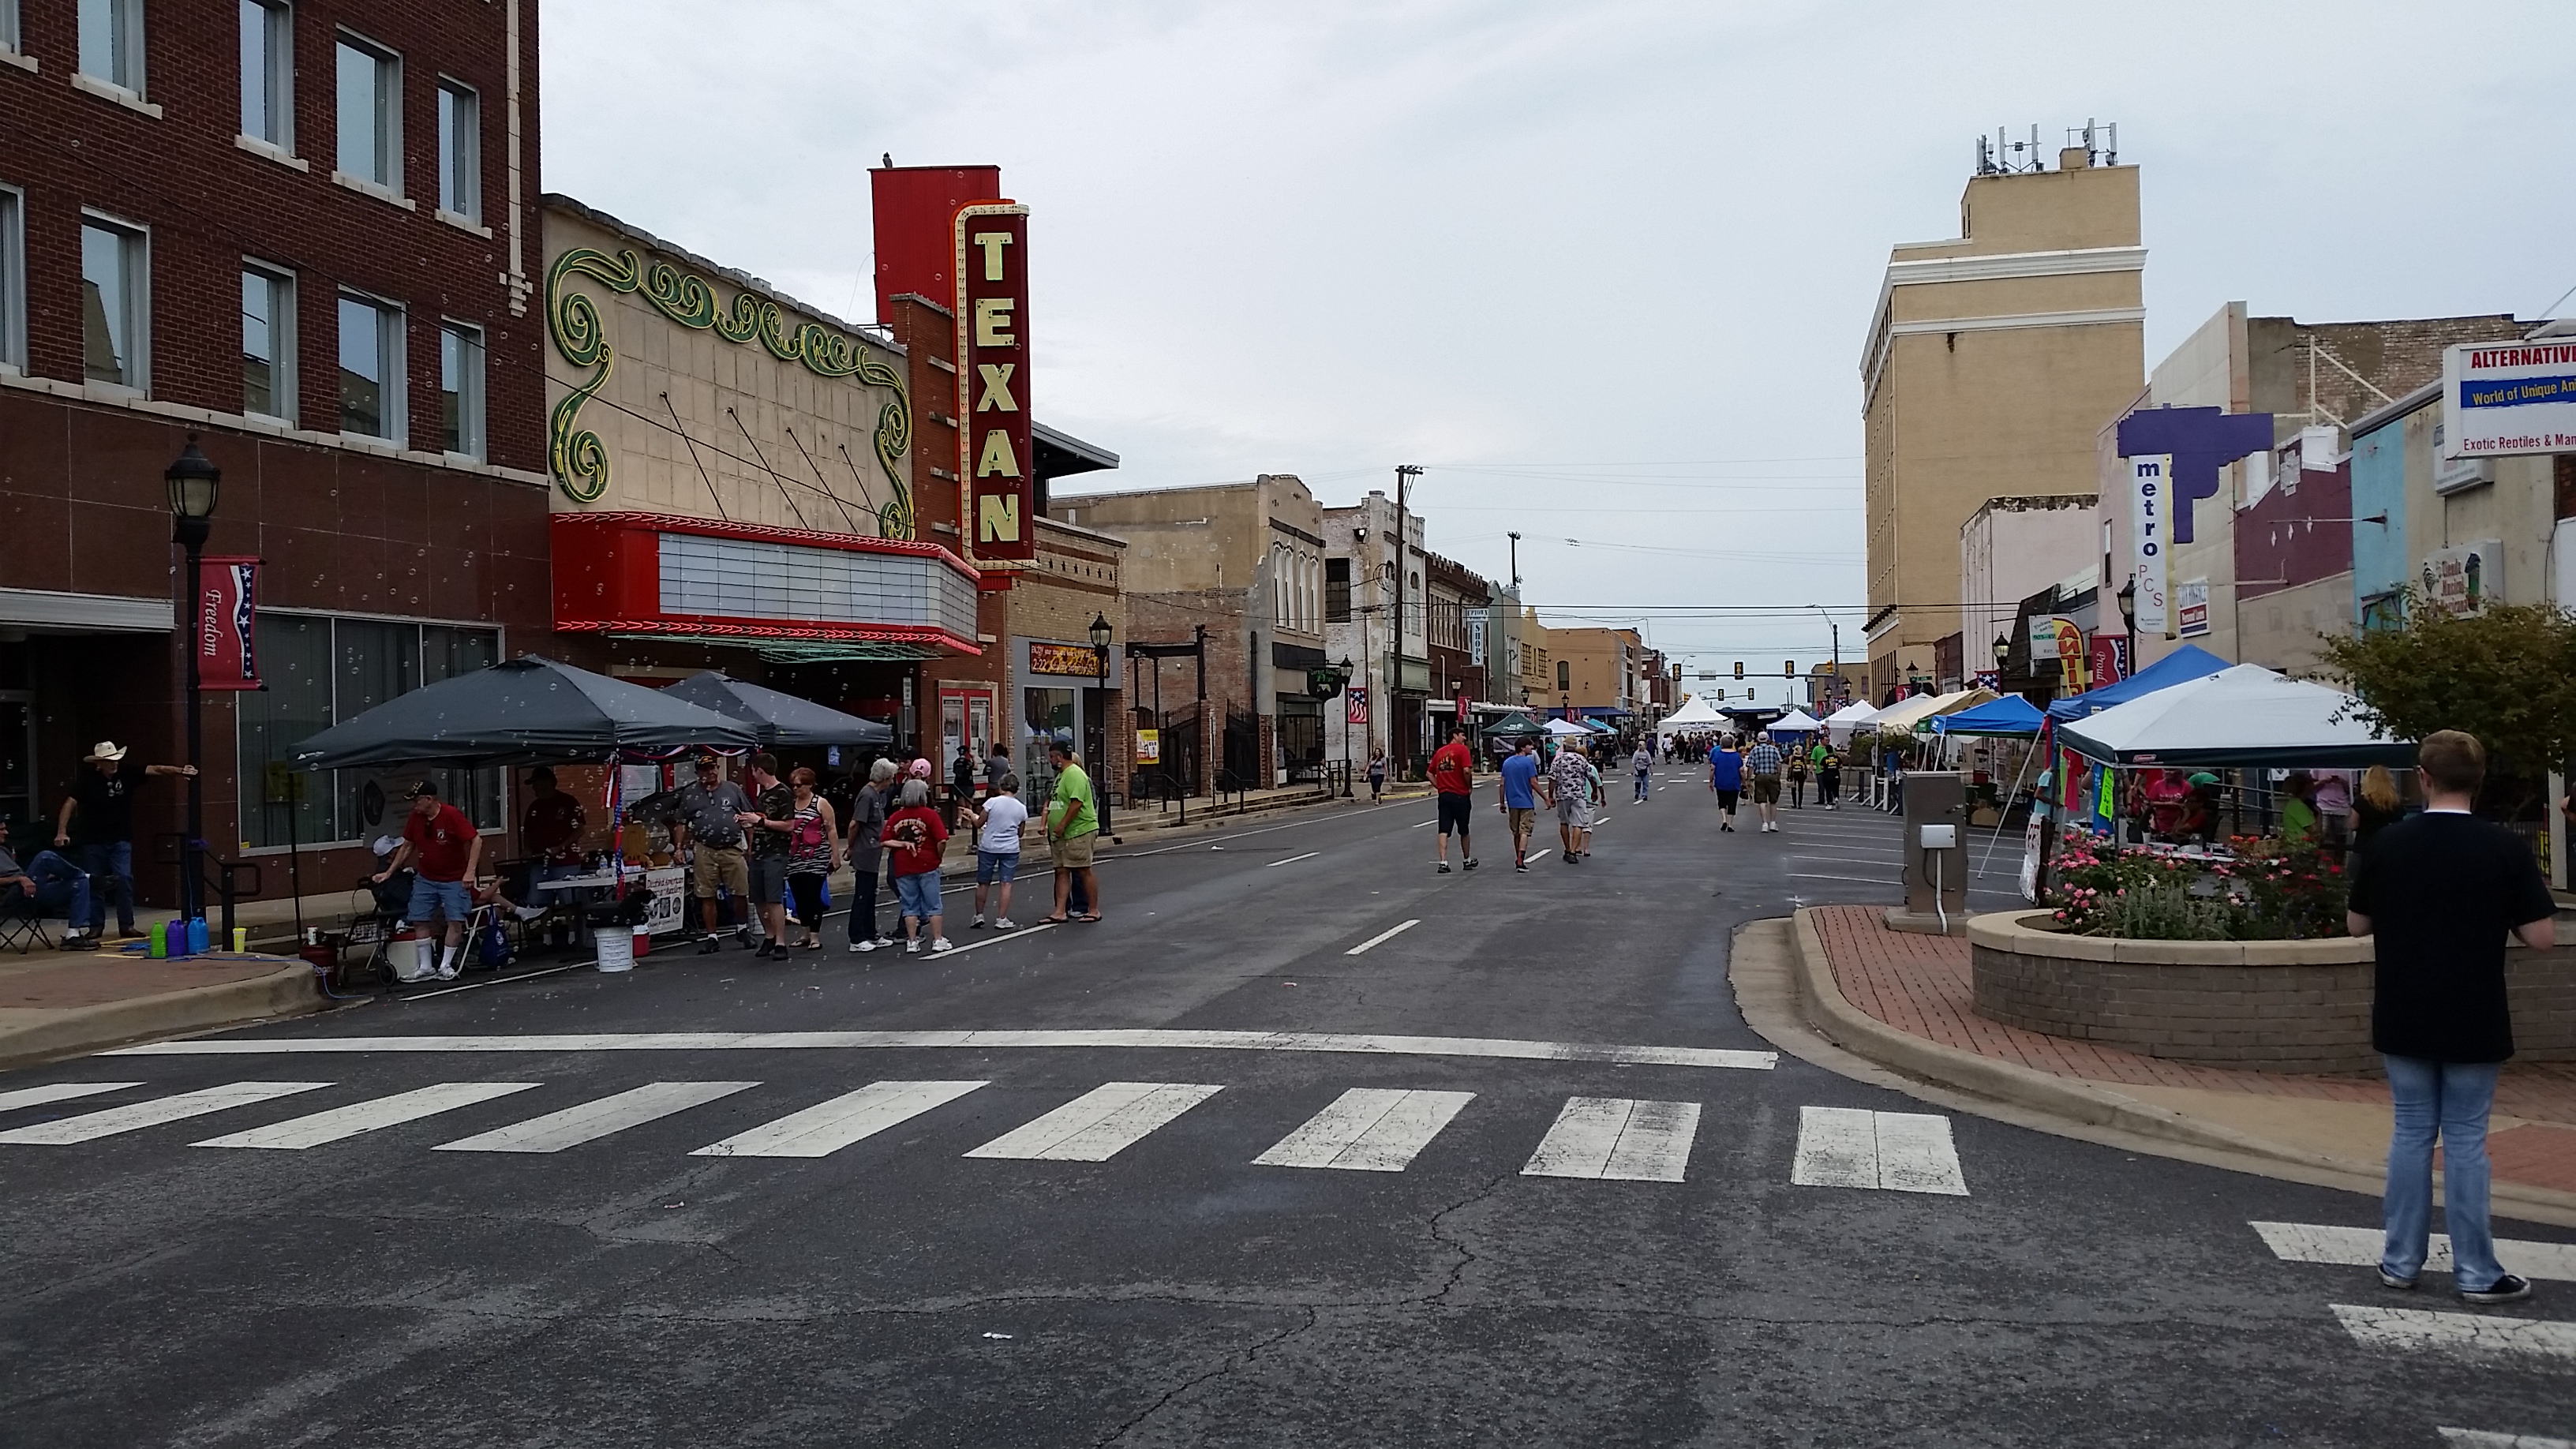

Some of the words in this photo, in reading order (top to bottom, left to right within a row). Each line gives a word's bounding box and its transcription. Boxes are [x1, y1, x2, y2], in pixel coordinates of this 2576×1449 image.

[973, 231, 1020, 543] TEXAN
[2473, 390, 2504, 405] World
[2507, 387, 2518, 400] of
[2521, 384, 2557, 399] Unique
[2464, 438, 2496, 451] Exotic
[2499, 435, 2540, 449] Reptiles
[2544, 434, 2552, 446] &
[2137, 462, 2160, 556] metro
[2138, 564, 2163, 607] PCS
[204, 589, 223, 657] Freedom
[2096, 651, 2108, 683] Proud
